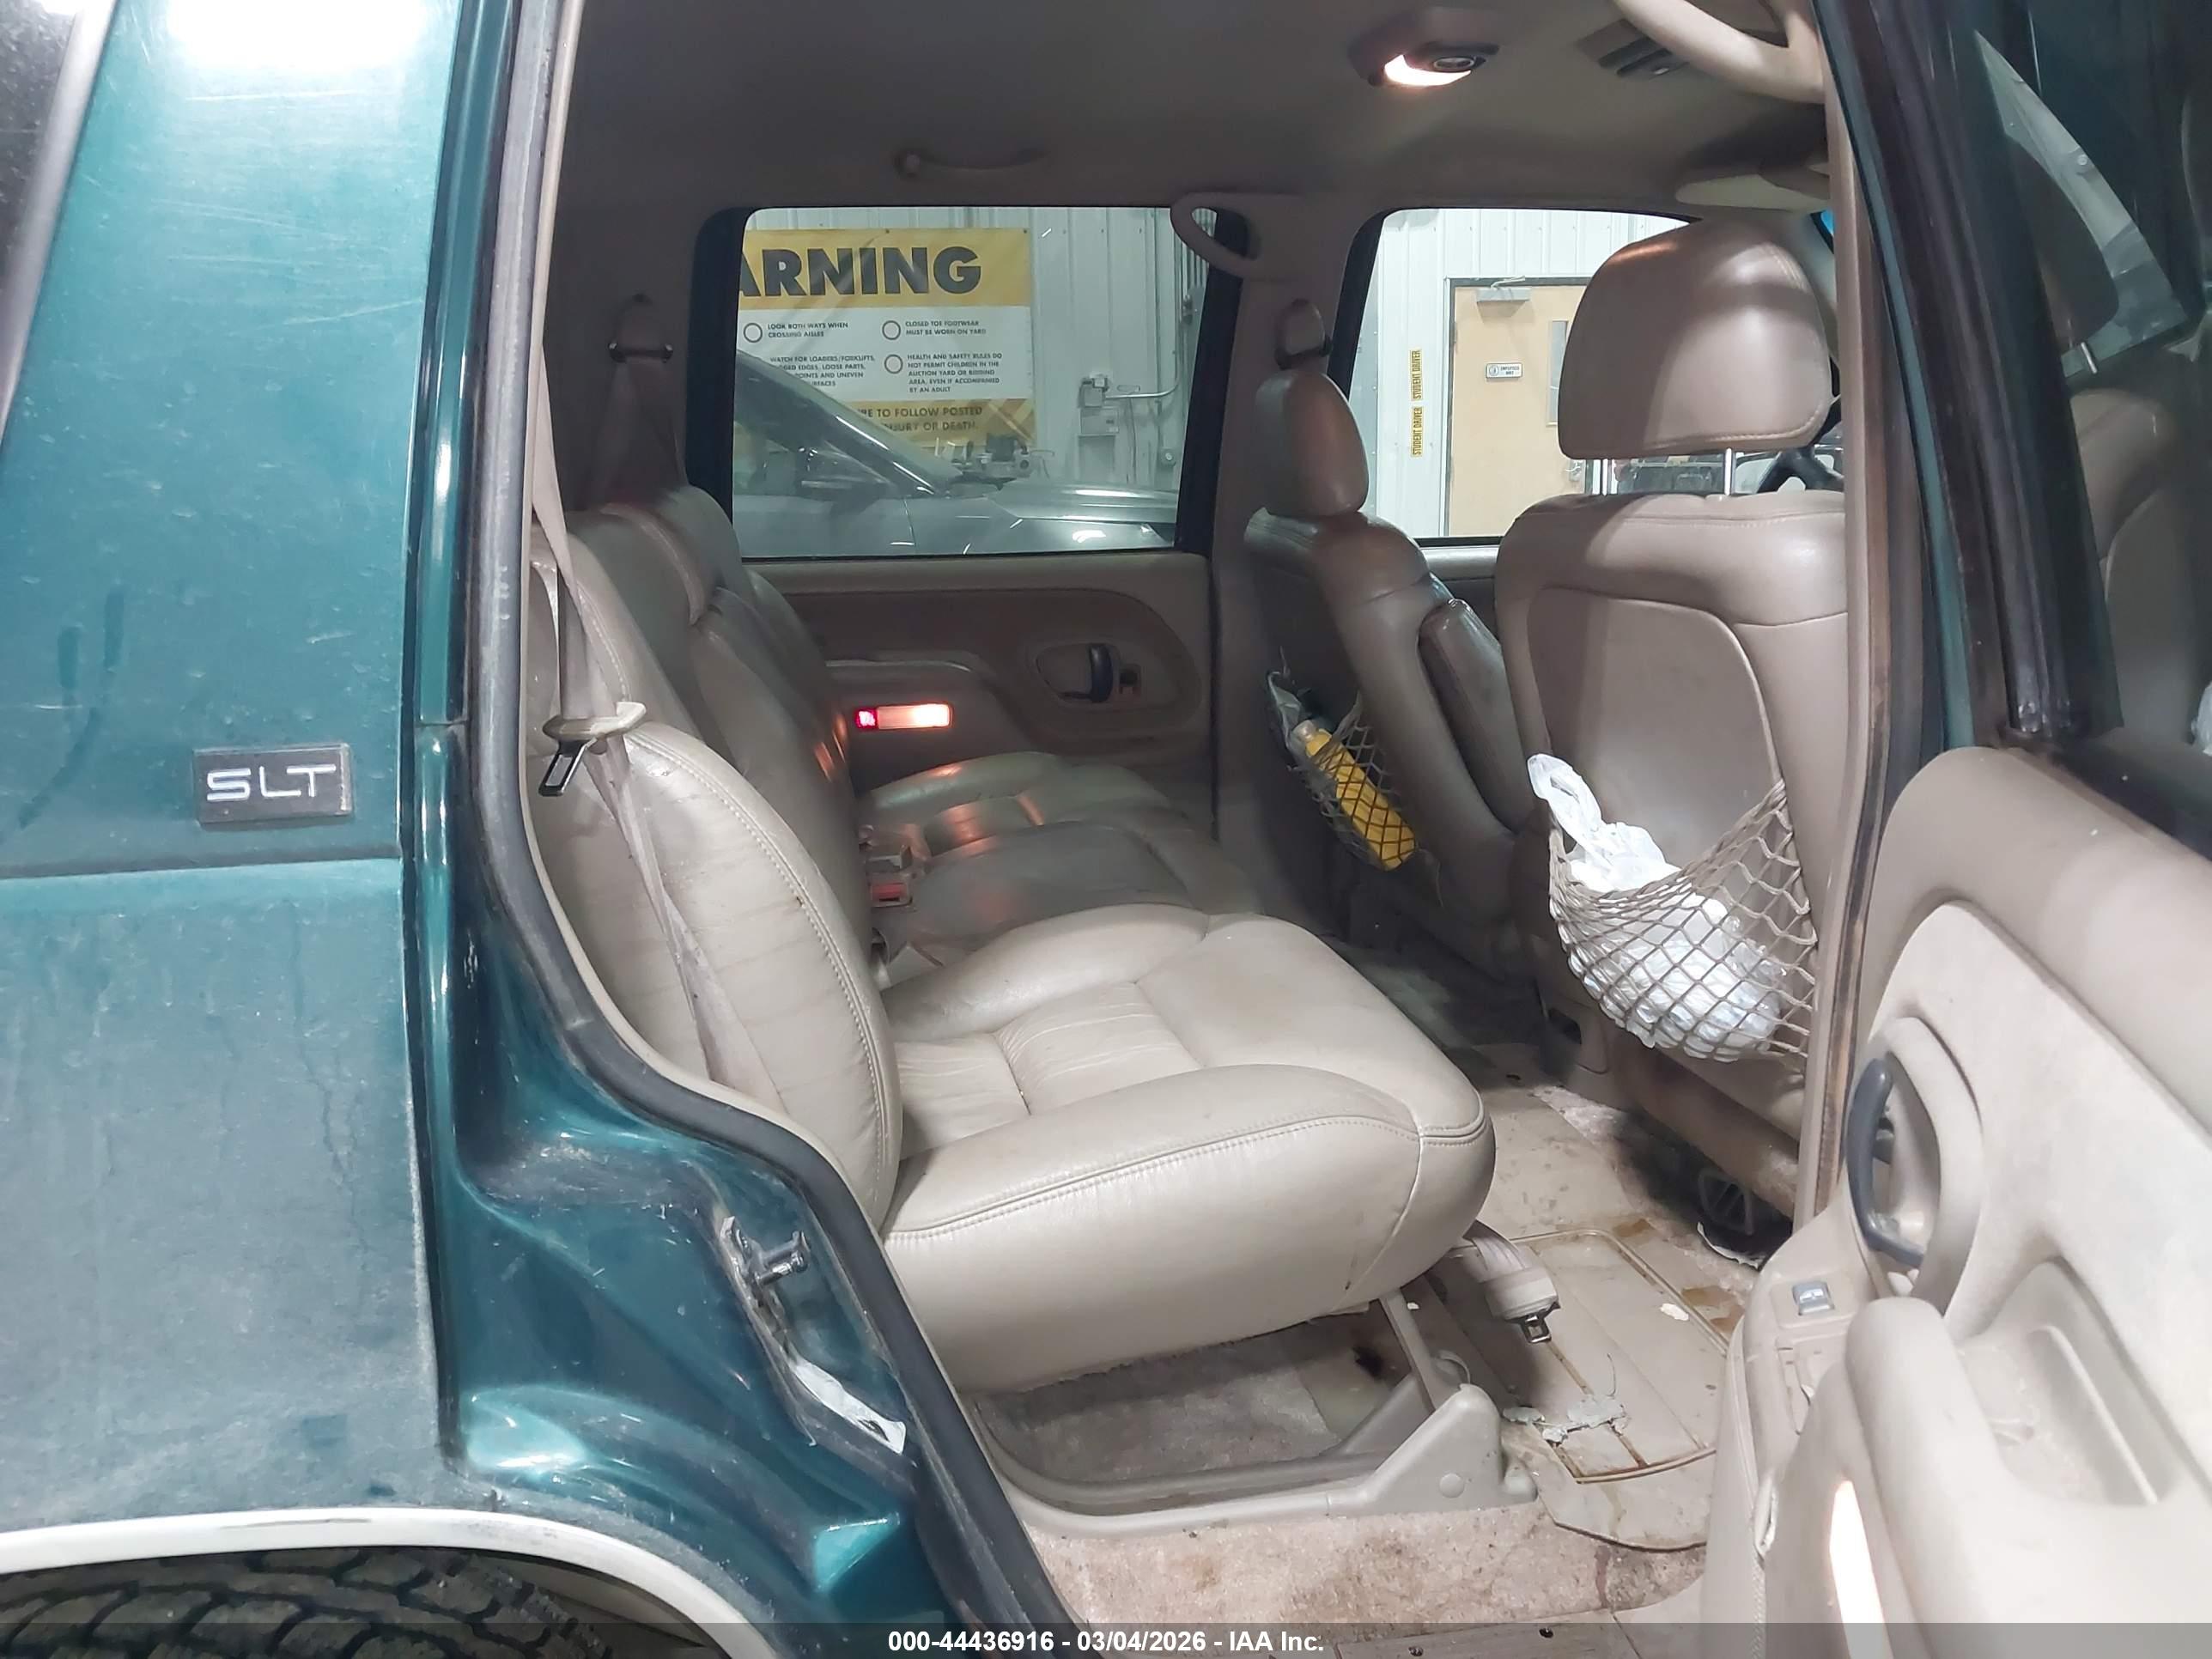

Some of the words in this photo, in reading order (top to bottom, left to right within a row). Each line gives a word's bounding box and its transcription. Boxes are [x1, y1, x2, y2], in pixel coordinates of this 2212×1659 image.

[1411, 349, 1421, 372] DRIVER
[1412, 374, 1422, 399] STUDENT
[876, 408, 891, 417] TO
[895, 407, 939, 417] FOLLOW
[943, 406, 983, 416] POSTED
[1413, 407, 1423, 428] DRIVER
[923, 422, 939, 431] OR
[1413, 429, 1423, 455] STUDENT
[206, 763, 337, 801] SLT
